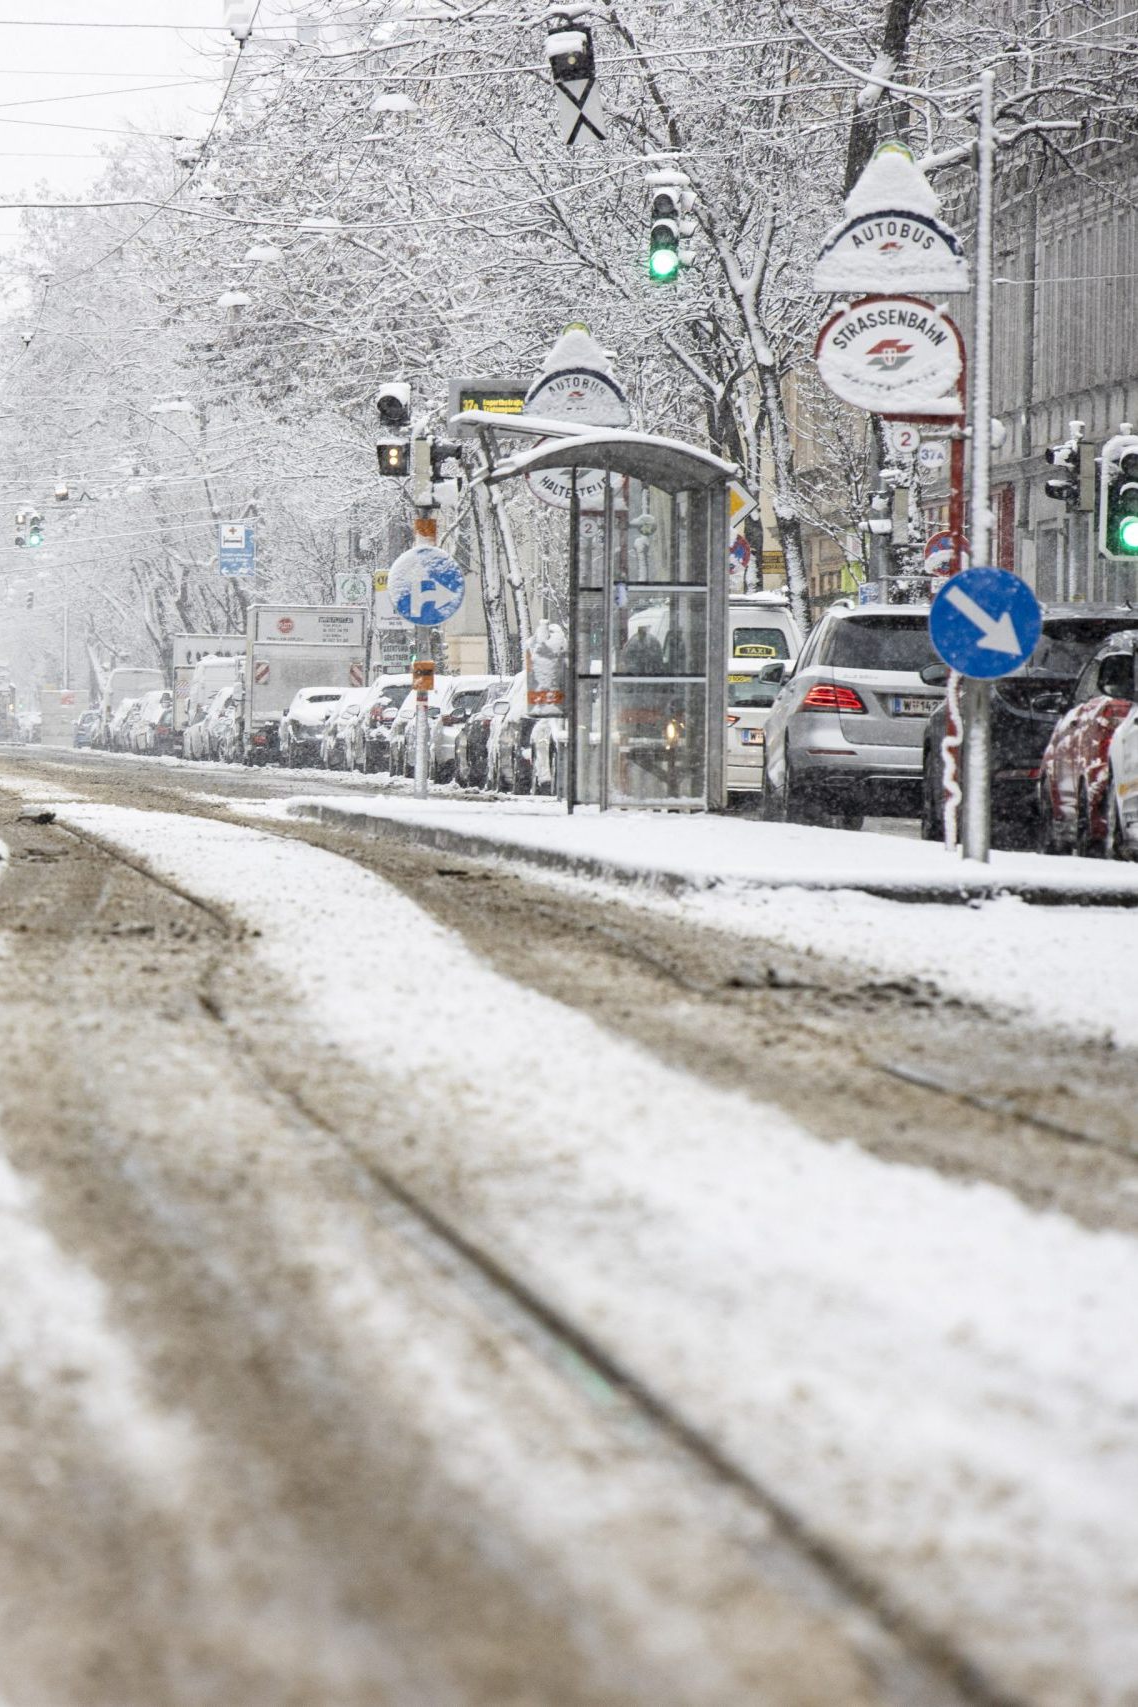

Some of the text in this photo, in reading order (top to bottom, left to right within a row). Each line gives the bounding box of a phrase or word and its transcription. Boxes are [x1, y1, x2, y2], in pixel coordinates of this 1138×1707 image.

[852, 221, 935, 250] AUTOBUS
[833, 309, 948, 350] STRASSENBAHN
[900, 431, 912, 447] 2
[921, 449, 945, 461] 37A
[584, 522, 593, 534] 2
[746, 647, 767, 655] TAXI
